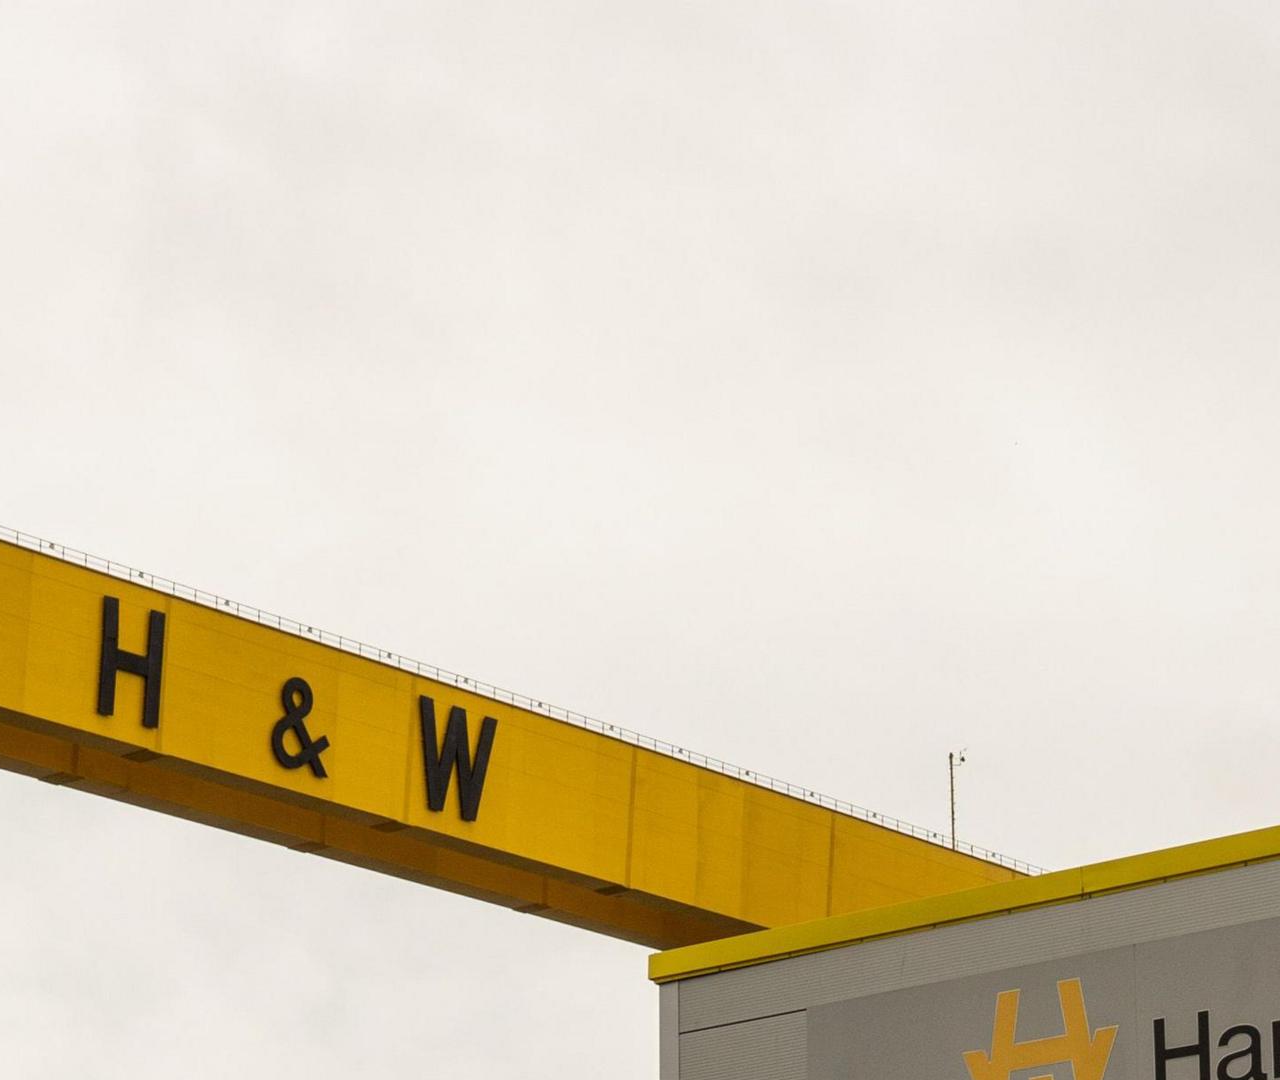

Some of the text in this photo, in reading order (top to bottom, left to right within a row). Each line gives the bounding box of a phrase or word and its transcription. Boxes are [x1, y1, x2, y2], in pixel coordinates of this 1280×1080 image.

[96, 595, 498, 822] H & W
